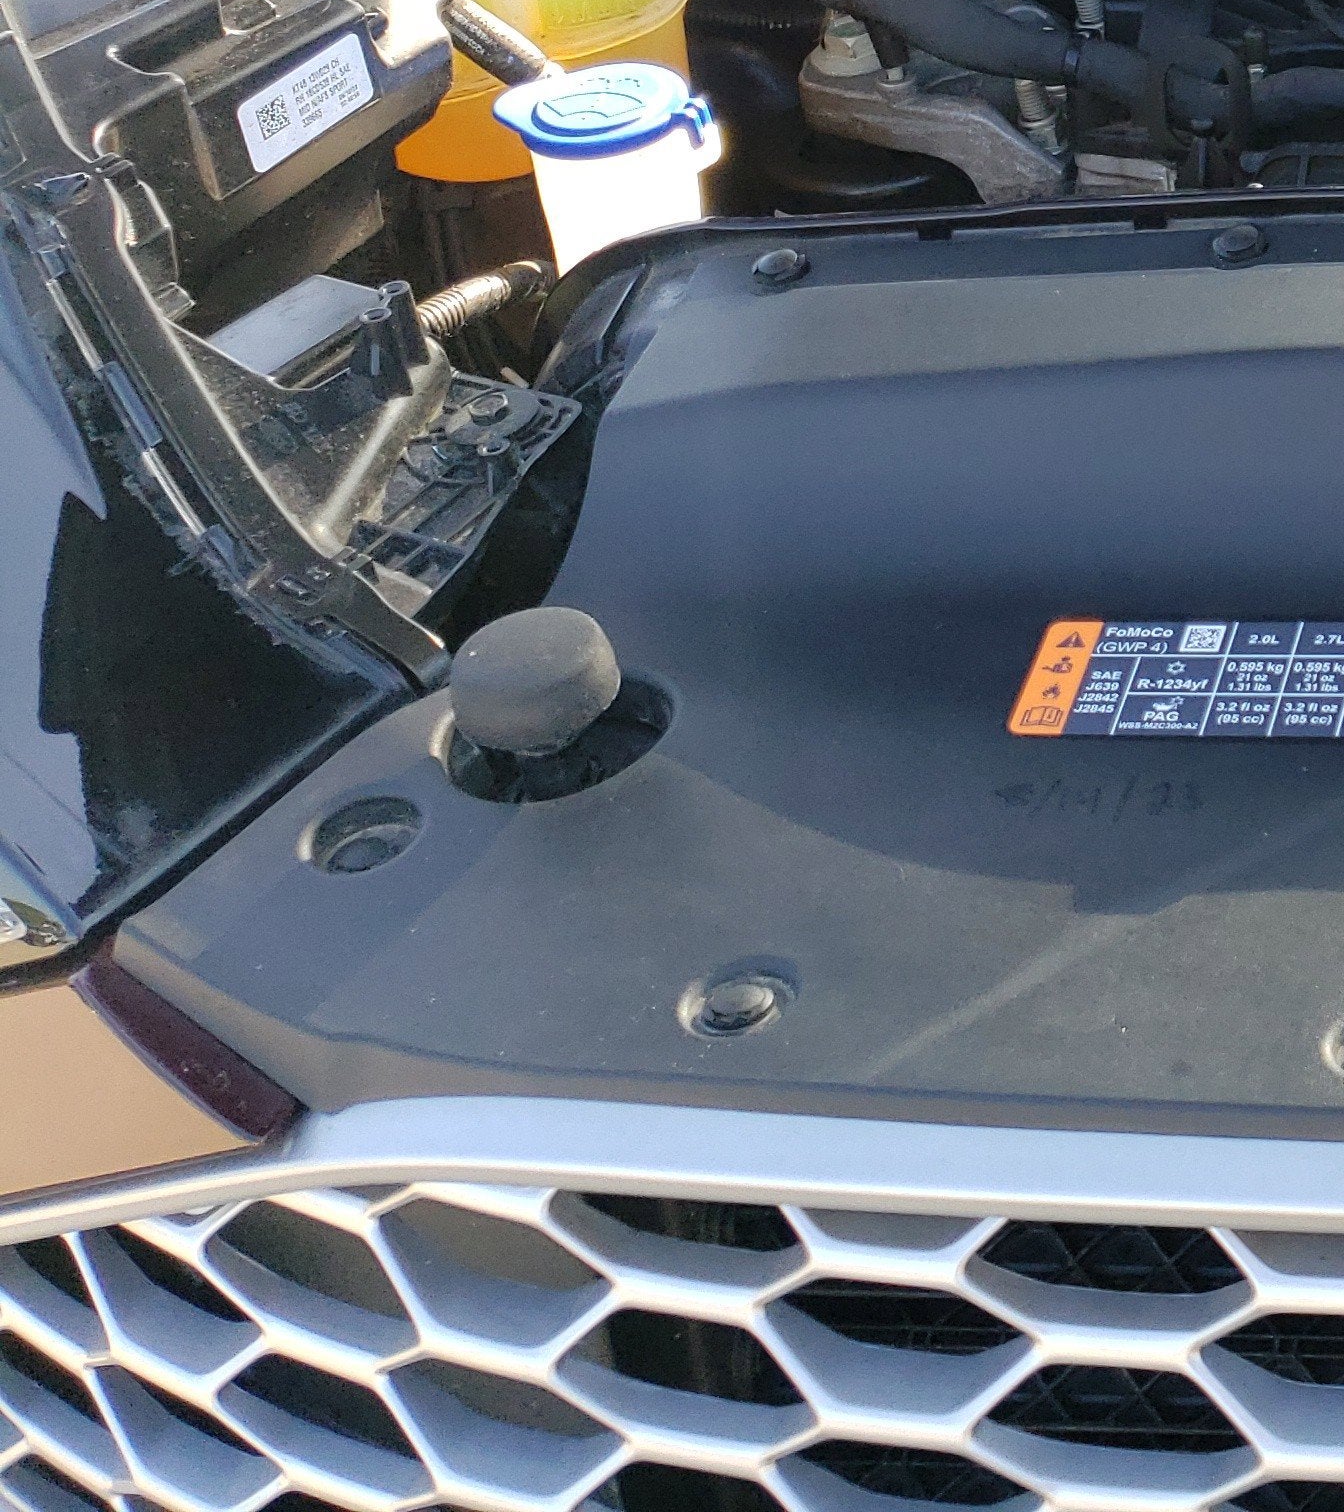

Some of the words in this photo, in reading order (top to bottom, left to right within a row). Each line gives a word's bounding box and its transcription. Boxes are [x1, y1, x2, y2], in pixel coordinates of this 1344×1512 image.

[1106, 626, 1174, 638] FoMoCo
[1248, 634, 1280, 645] 2.0L
[1096, 641, 1147, 655] (GWP
[1151, 641, 1169, 655] 4)
[1227, 661, 1264, 673] 0.595
[1267, 661, 1285, 675] kg
[1293, 661, 1330, 673] 0.595
[1091, 670, 1123, 680] SAE
[1236, 673, 1251, 682] 21
[1253, 674, 1268, 682] oz
[1303, 673, 1318, 682] 21
[1320, 674, 1335, 682] oz
[1085, 681, 1120, 691] J639
[1136, 678, 1209, 692] R-1234yf
[1226, 683, 1251, 692] 1.31
[1254, 683, 1272, 692] lbs
[1295, 683, 1318, 692] 1.31
[1321, 683, 1339, 692] lbs
[1078, 692, 1119, 702] J2842
[1216, 701, 1238, 712] 3.2
[1240, 701, 1251, 712] fl
[1253, 703, 1271, 713] oz
[1283, 701, 1306, 712] 3.2
[1308, 701, 1319, 712] fl
[1320, 703, 1339, 713] oz
[1143, 710, 1180, 722] PAG
[1217, 713, 1241, 726] (95
[1242, 714, 1265, 726] cc)
[1285, 713, 1308, 726] (95
[1310, 714, 1333, 726] cc)
